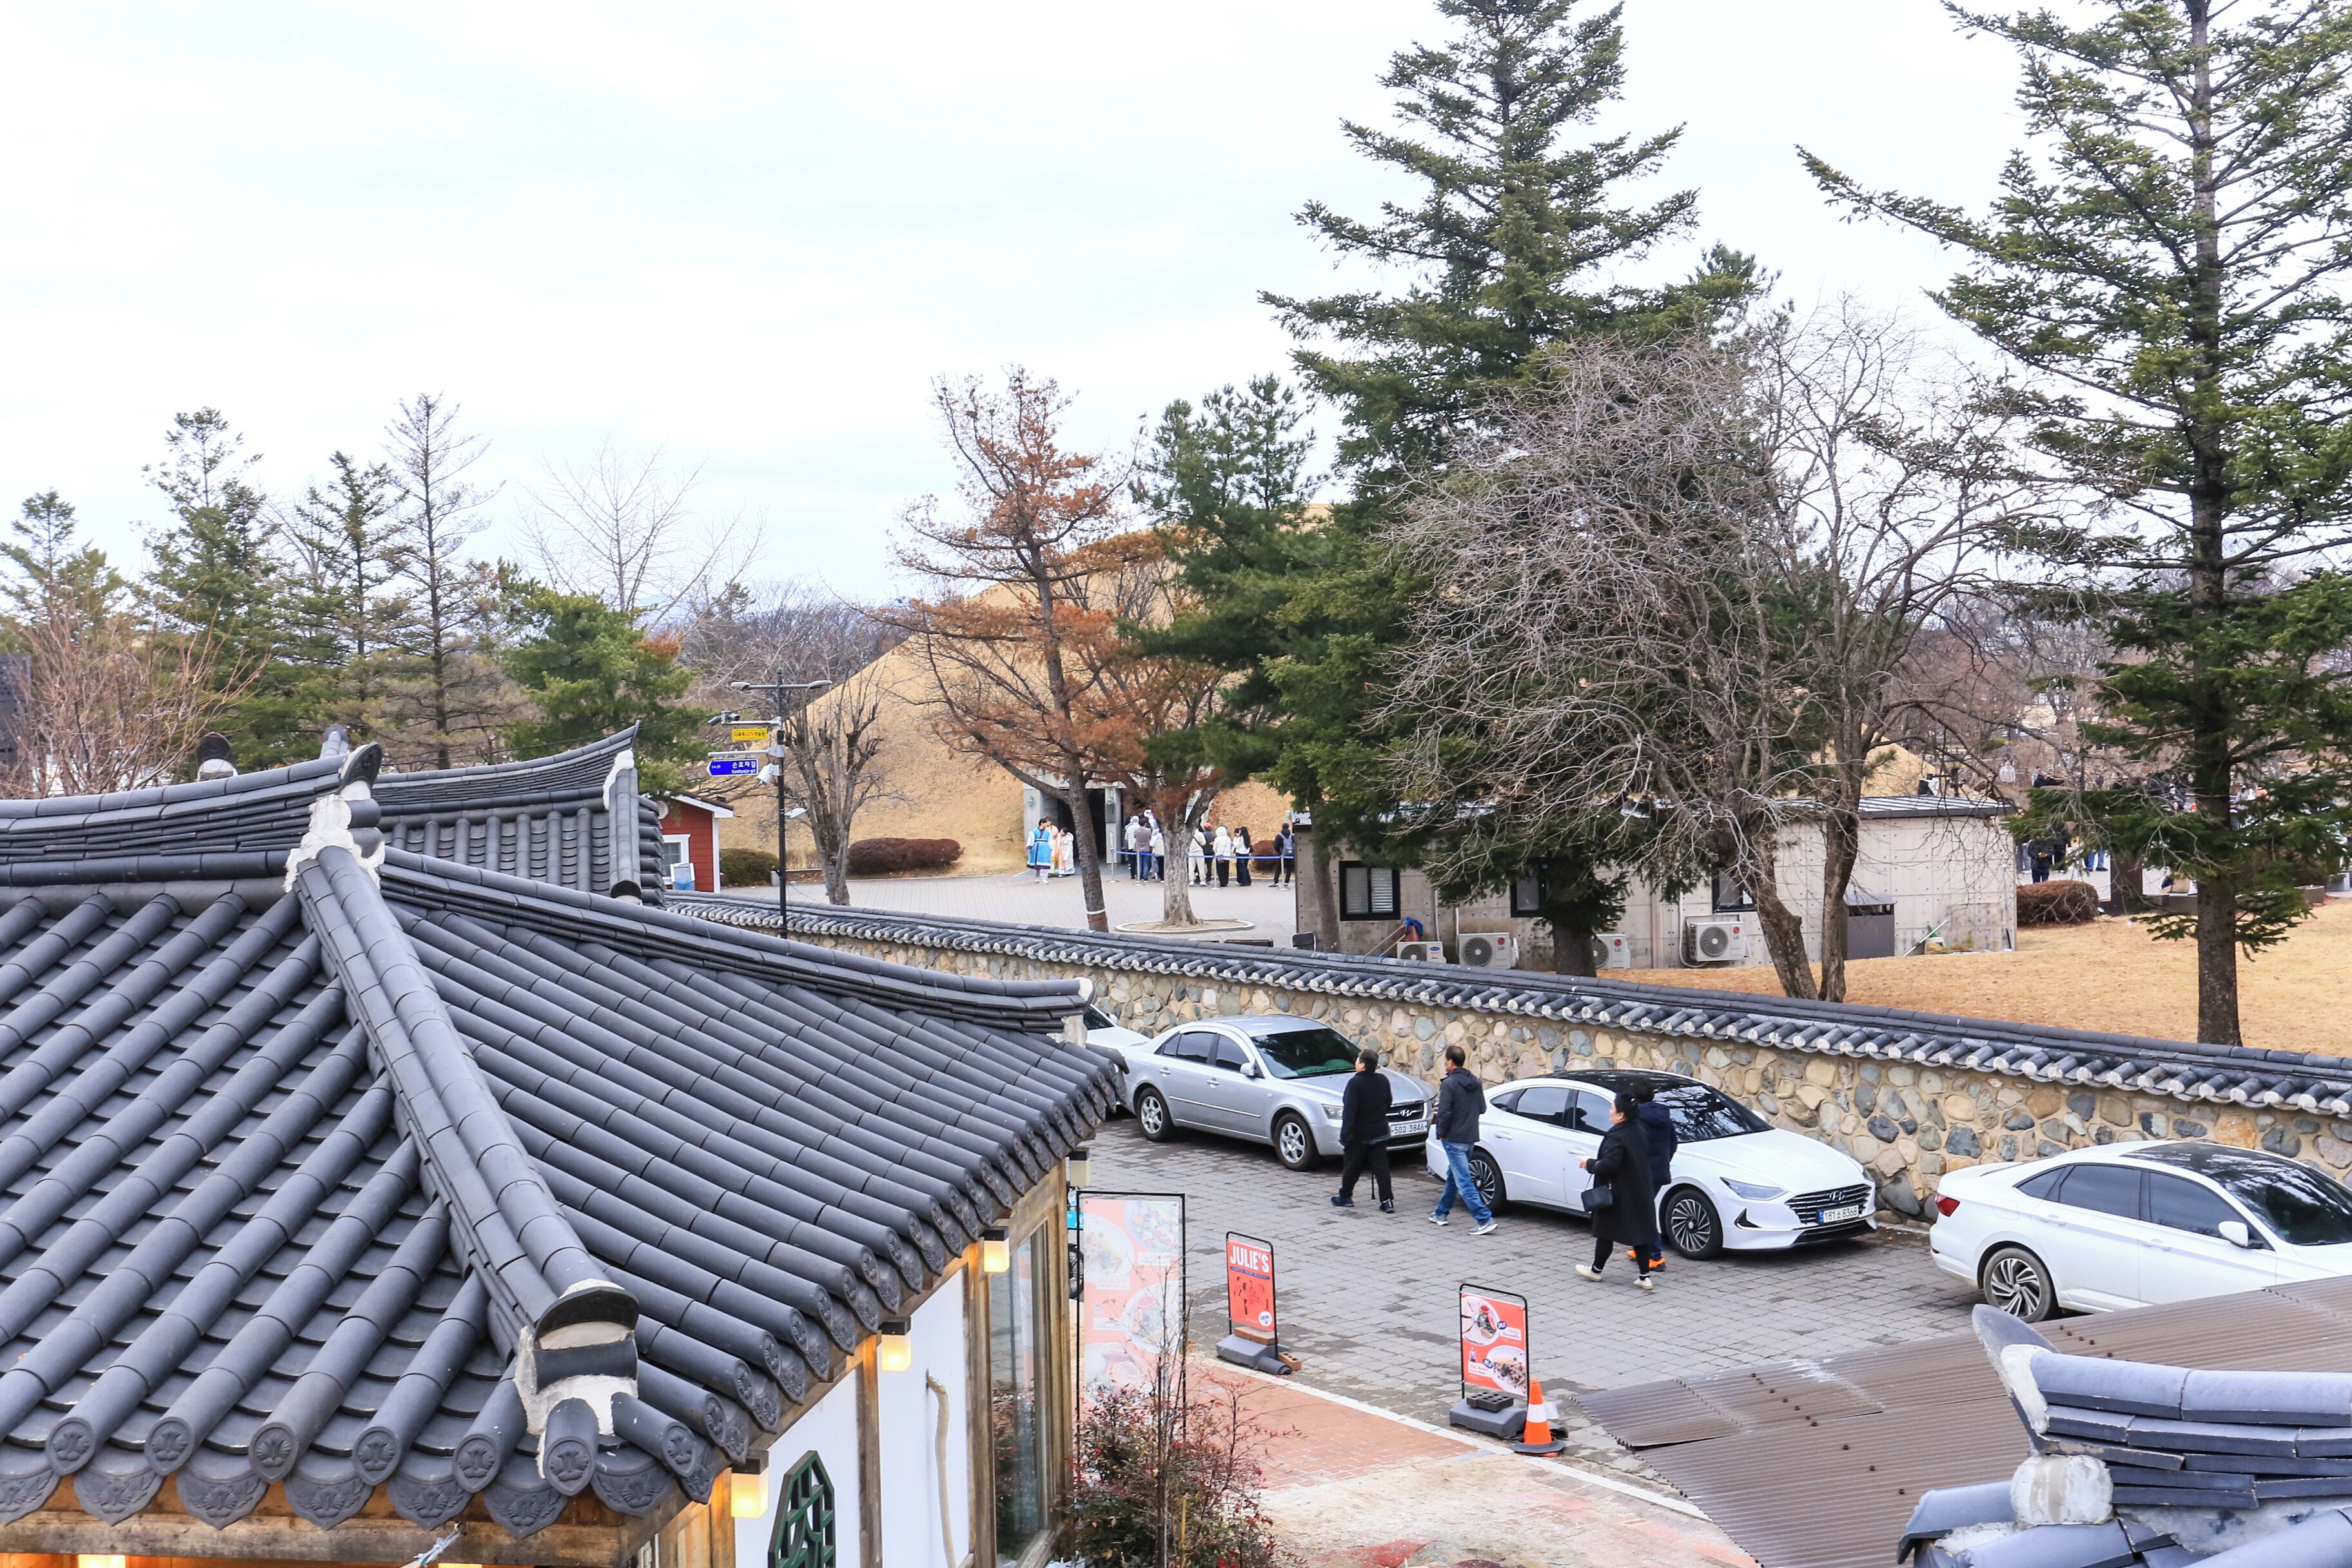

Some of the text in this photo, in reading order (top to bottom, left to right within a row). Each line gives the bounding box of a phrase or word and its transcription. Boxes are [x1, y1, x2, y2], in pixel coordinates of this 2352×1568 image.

[1409, 1124, 1424, 1132] 3846
[1842, 1206, 1857, 1218] 8368
[1230, 1245, 1269, 1273] JULIE'S
